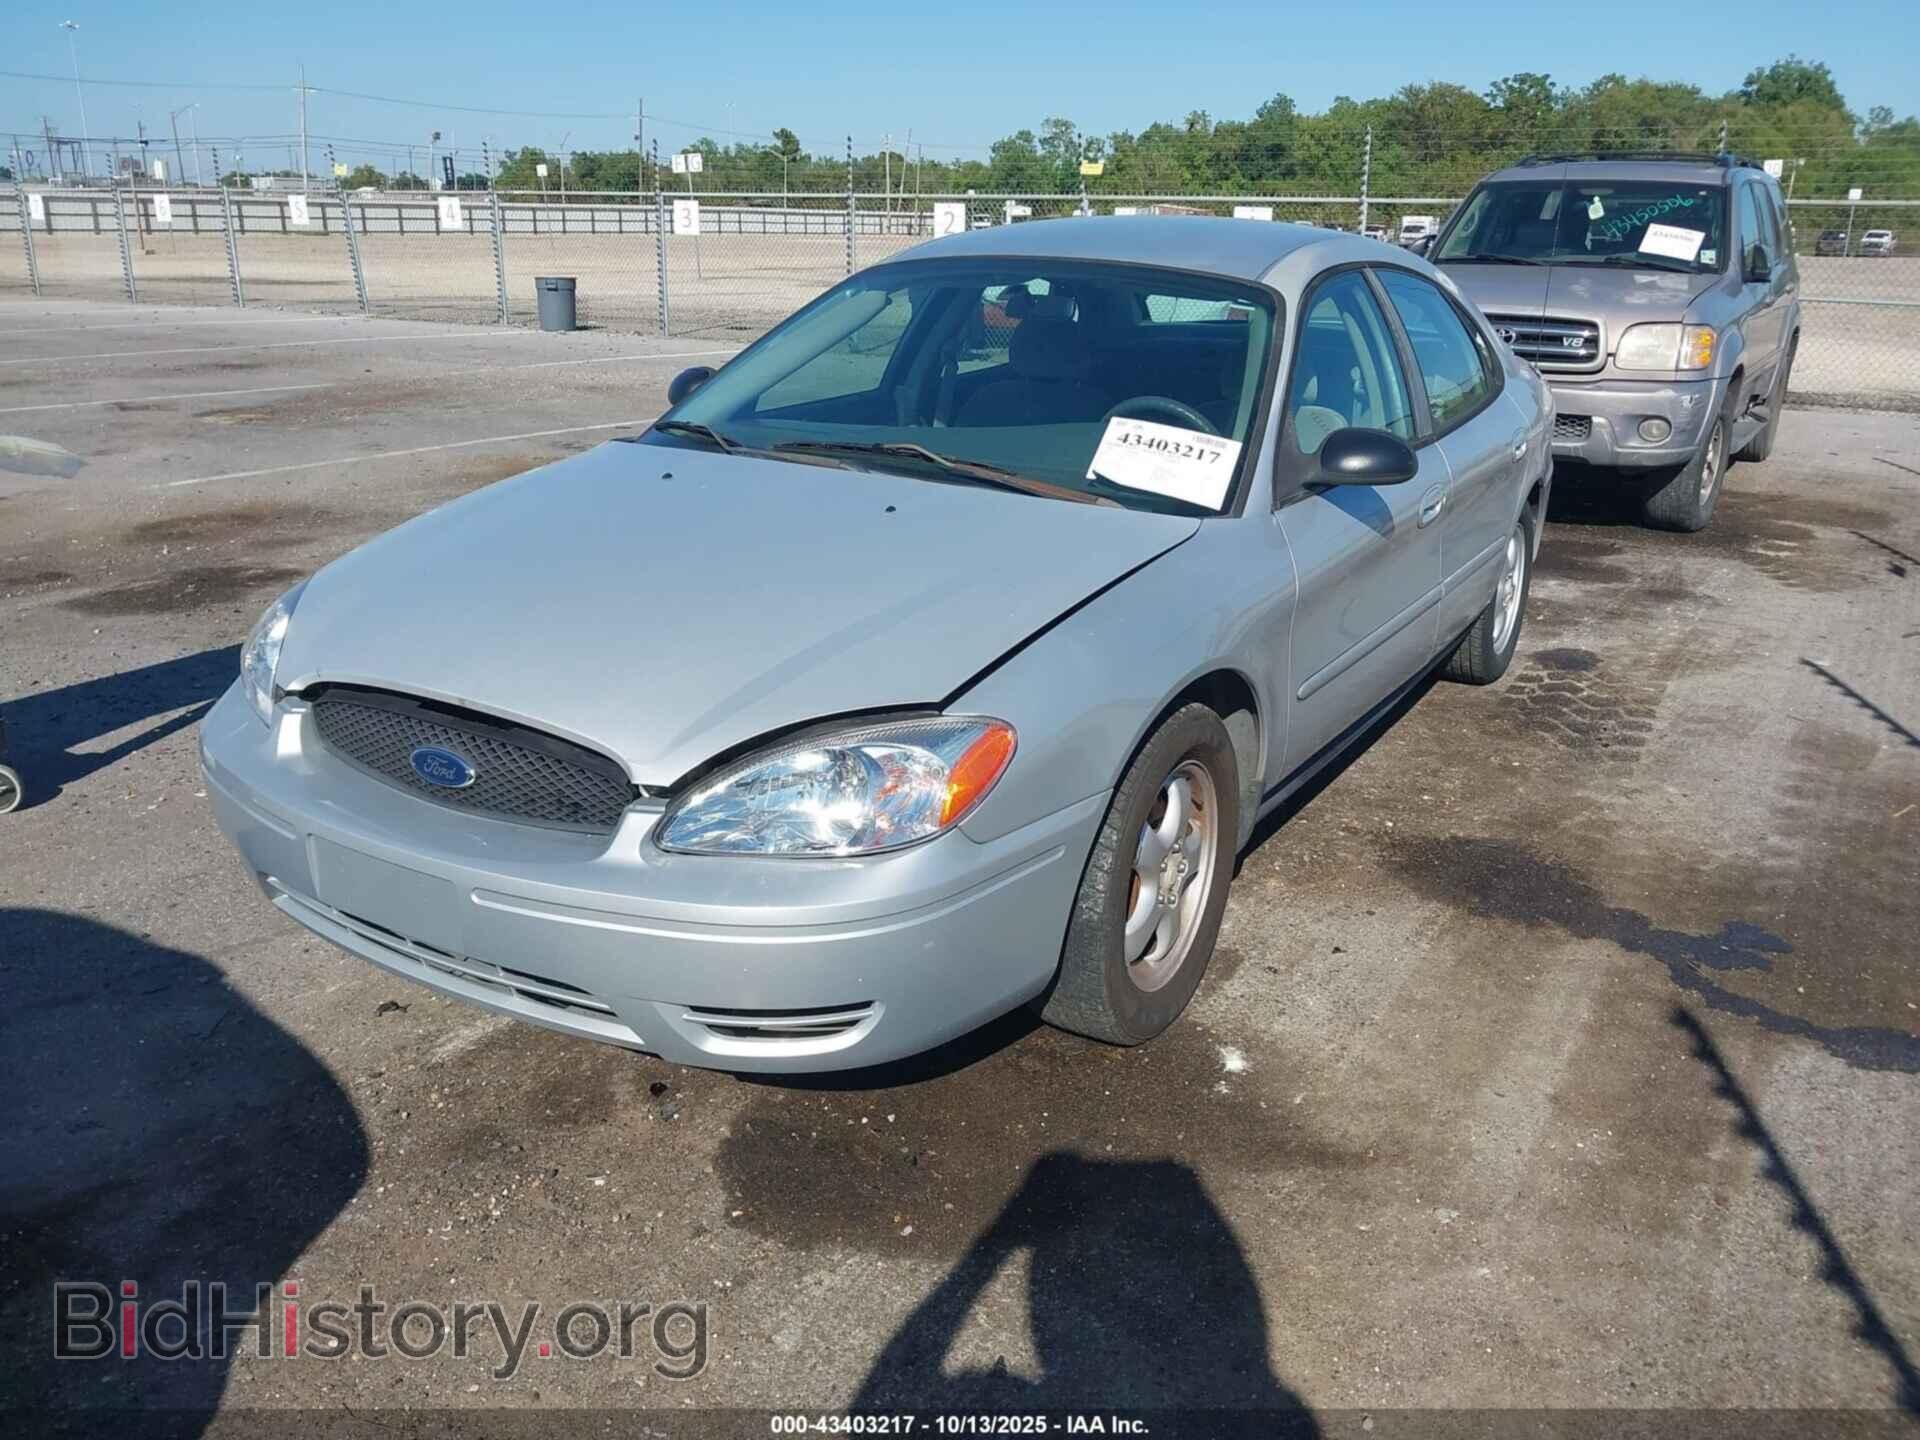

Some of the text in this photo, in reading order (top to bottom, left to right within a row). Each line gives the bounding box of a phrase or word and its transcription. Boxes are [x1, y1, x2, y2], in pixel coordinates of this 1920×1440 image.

[446, 203, 456, 222] 4
[681, 207, 692, 228] 3
[943, 211, 955, 234] 2
[1563, 336, 1585, 347] V8
[1117, 432, 1221, 465] 43403217
[424, 755, 457, 780] Ford
